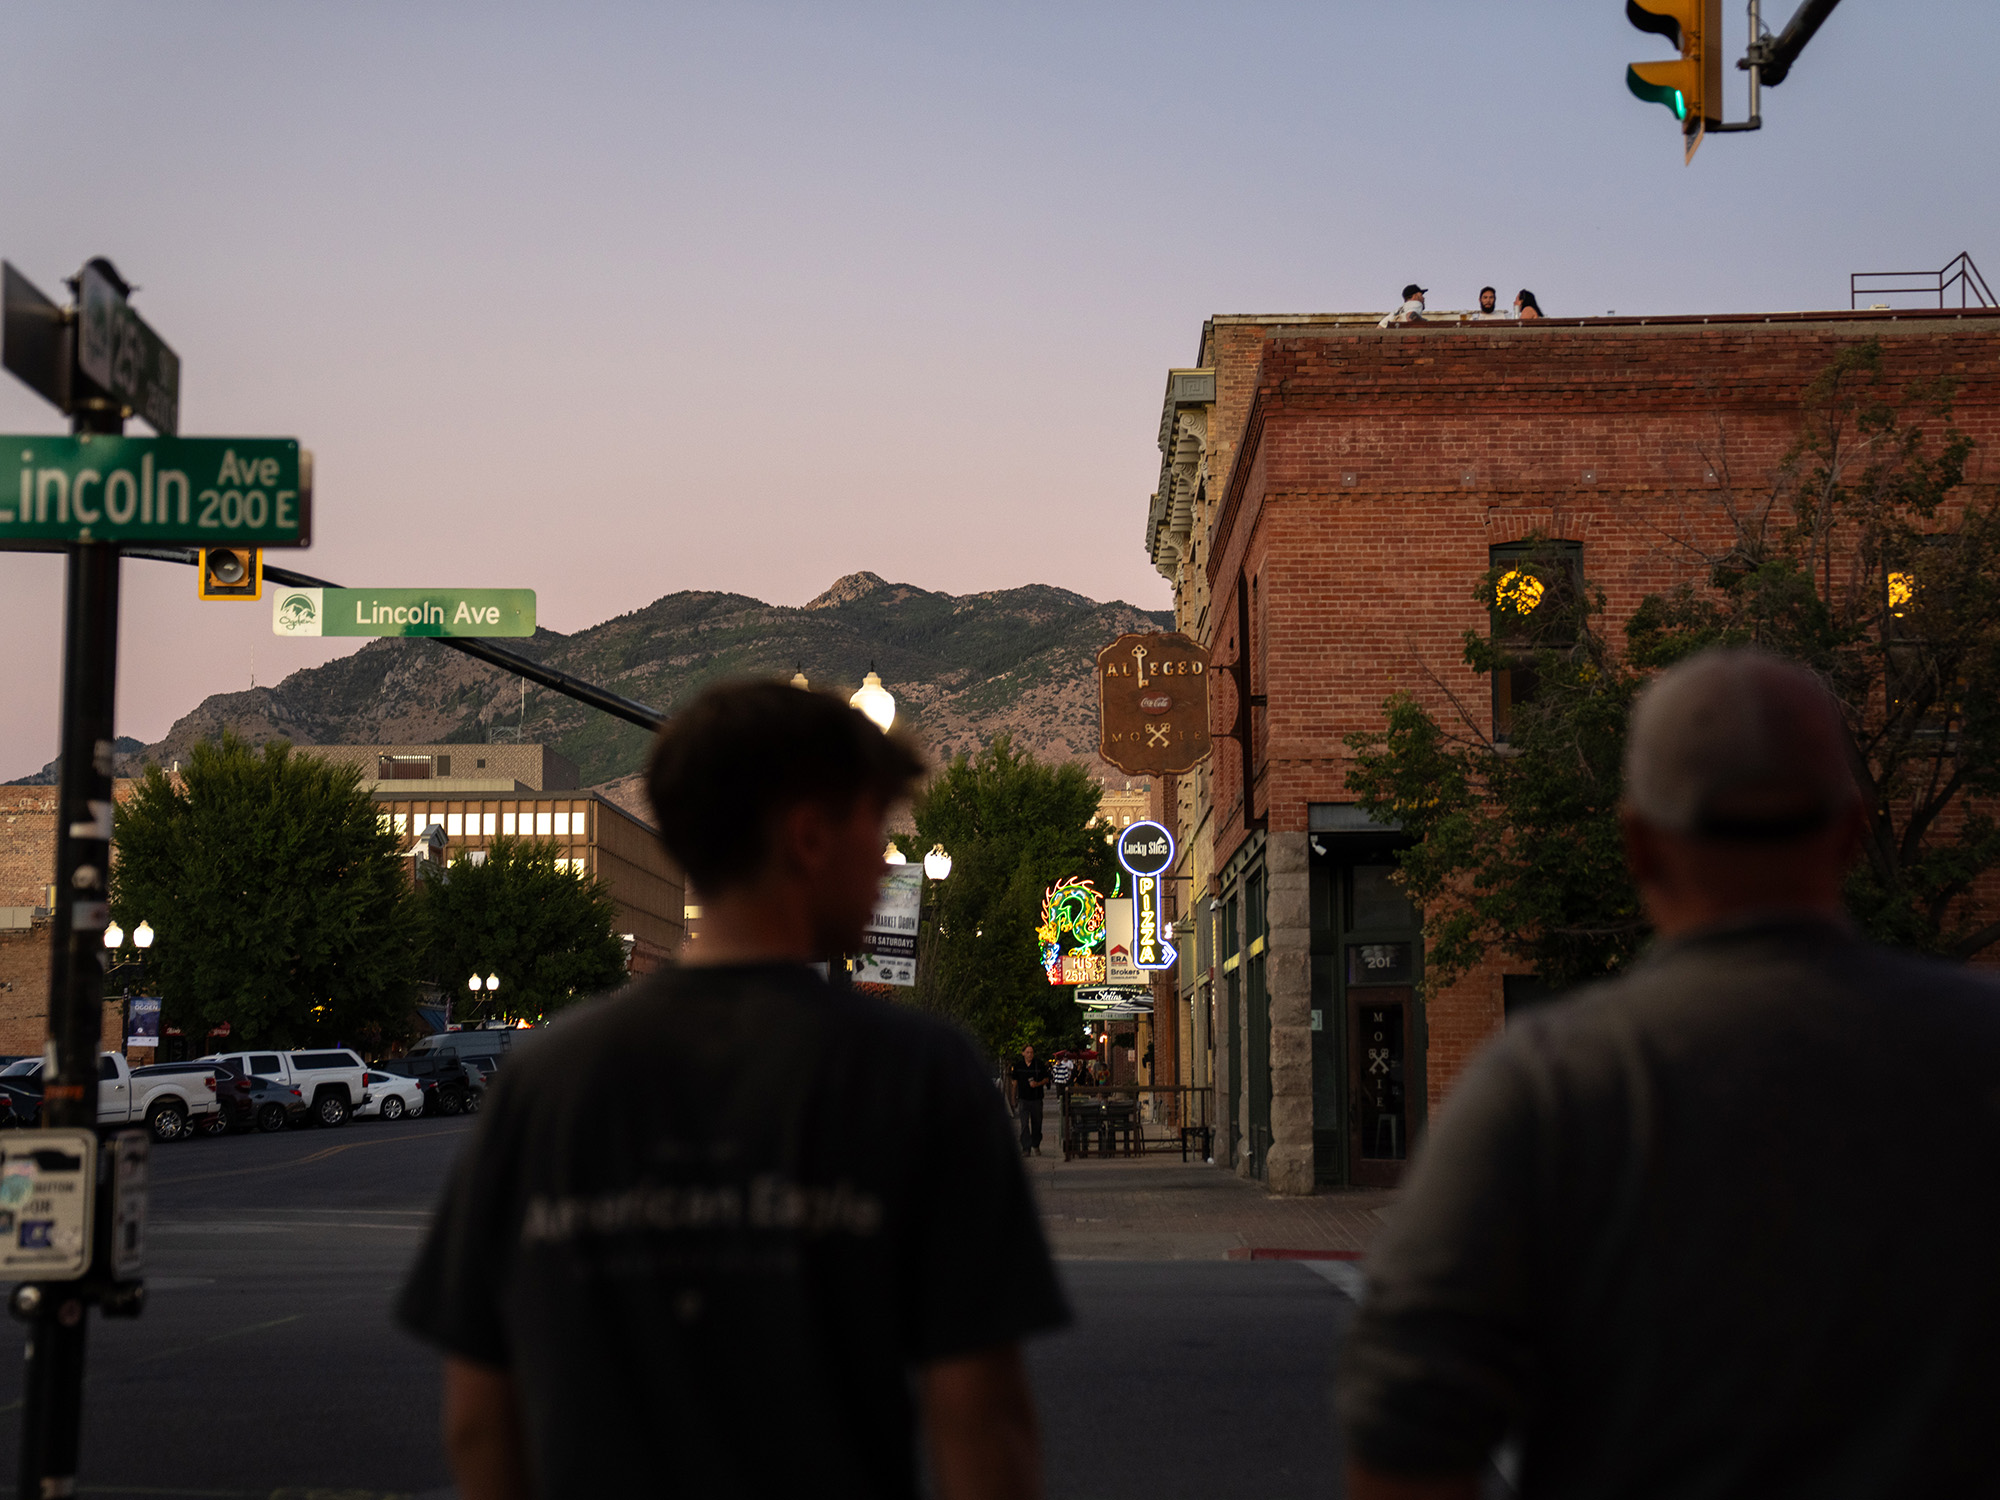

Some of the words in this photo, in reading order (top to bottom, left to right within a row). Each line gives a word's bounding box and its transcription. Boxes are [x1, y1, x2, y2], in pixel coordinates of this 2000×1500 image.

[217, 448, 280, 487] Ave
[198, 490, 268, 528] 200
[276, 490, 298, 528] E
[356, 601, 444, 625] Lincoln
[453, 601, 501, 625] Ave
[1123, 842, 1147, 857] Lucky
[1148, 841, 1168, 855] Slice
[875, 914, 897, 928] MARKET
[898, 915, 916, 930] OGDEN
[1139, 877, 1155, 963] PIZZA
[877, 936, 914, 948] SATURDAYS
[1367, 956, 1390, 969] 201
[1111, 968, 1140, 976] Brokers
